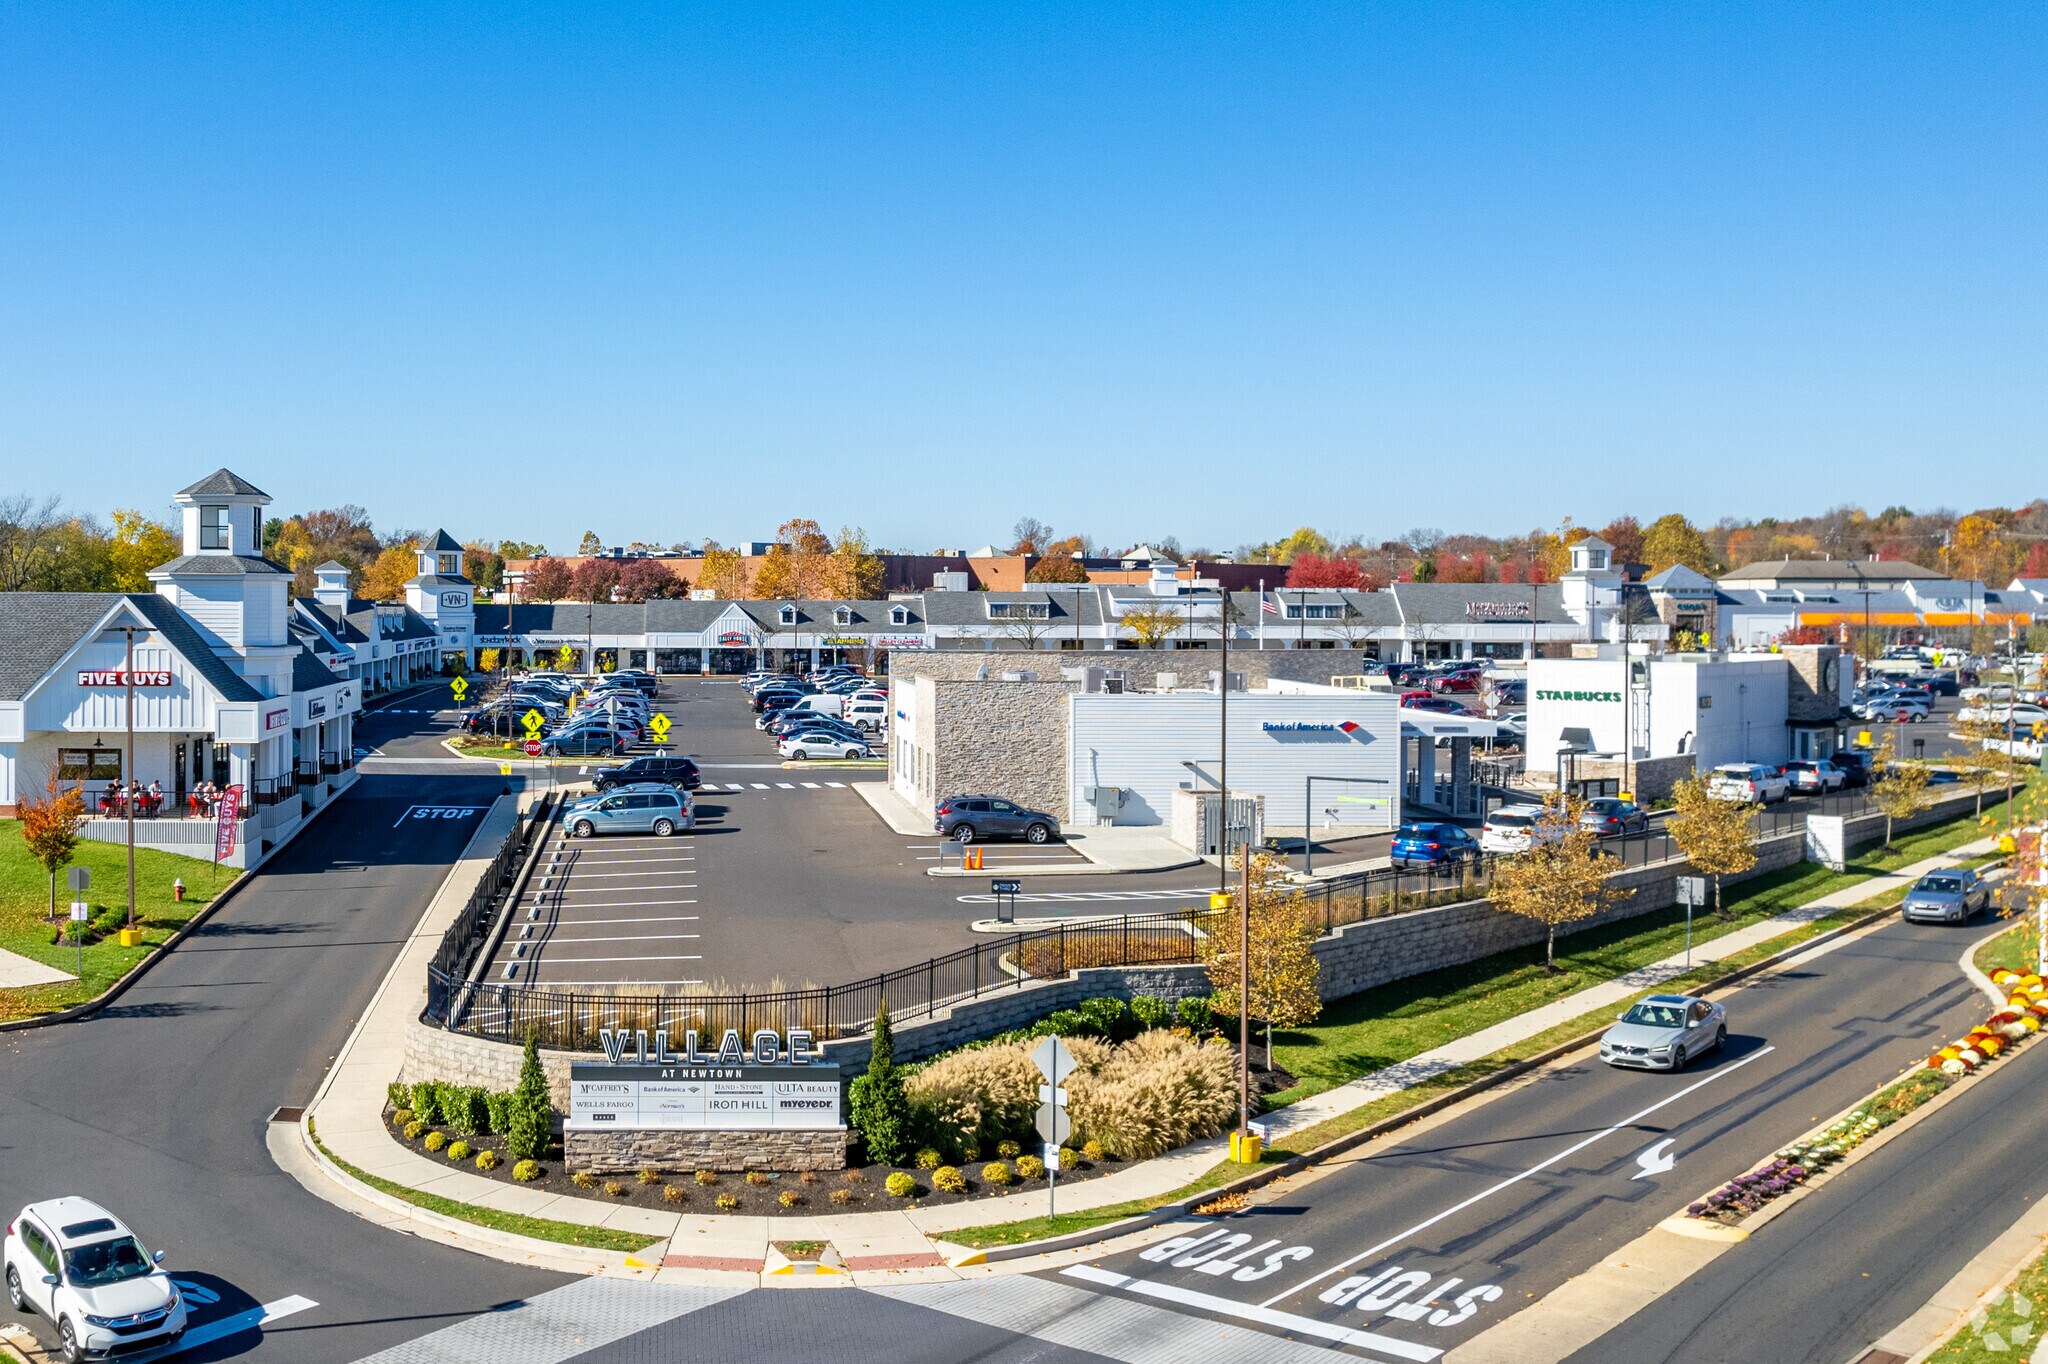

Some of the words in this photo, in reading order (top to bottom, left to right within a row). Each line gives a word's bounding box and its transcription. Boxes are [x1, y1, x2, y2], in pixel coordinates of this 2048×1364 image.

[447, 594, 461, 605] VN
[78, 672, 117, 686] FIVE
[1536, 689, 1622, 703] STARBUCKS
[1262, 721, 1286, 731] Bank
[1287, 721, 1296, 731] of
[1296, 721, 1334, 731] America
[525, 744, 541, 752] STOP
[222, 793, 236, 825] GUYS
[412, 808, 475, 820] STOP
[220, 827, 230, 854] FIVE
[600, 1028, 813, 1066] VILLAGE
[661, 1069, 675, 1079] AT
[683, 1069, 743, 1079] NEWTOWN
[777, 1083, 805, 1093] ULTA
[806, 1085, 838, 1093] BEAUTY
[709, 1100, 738, 1110] IRON
[742, 1100, 768, 1110] HILL
[1138, 1228, 1314, 1283] STOP
[1317, 1266, 1504, 1328] STOP
